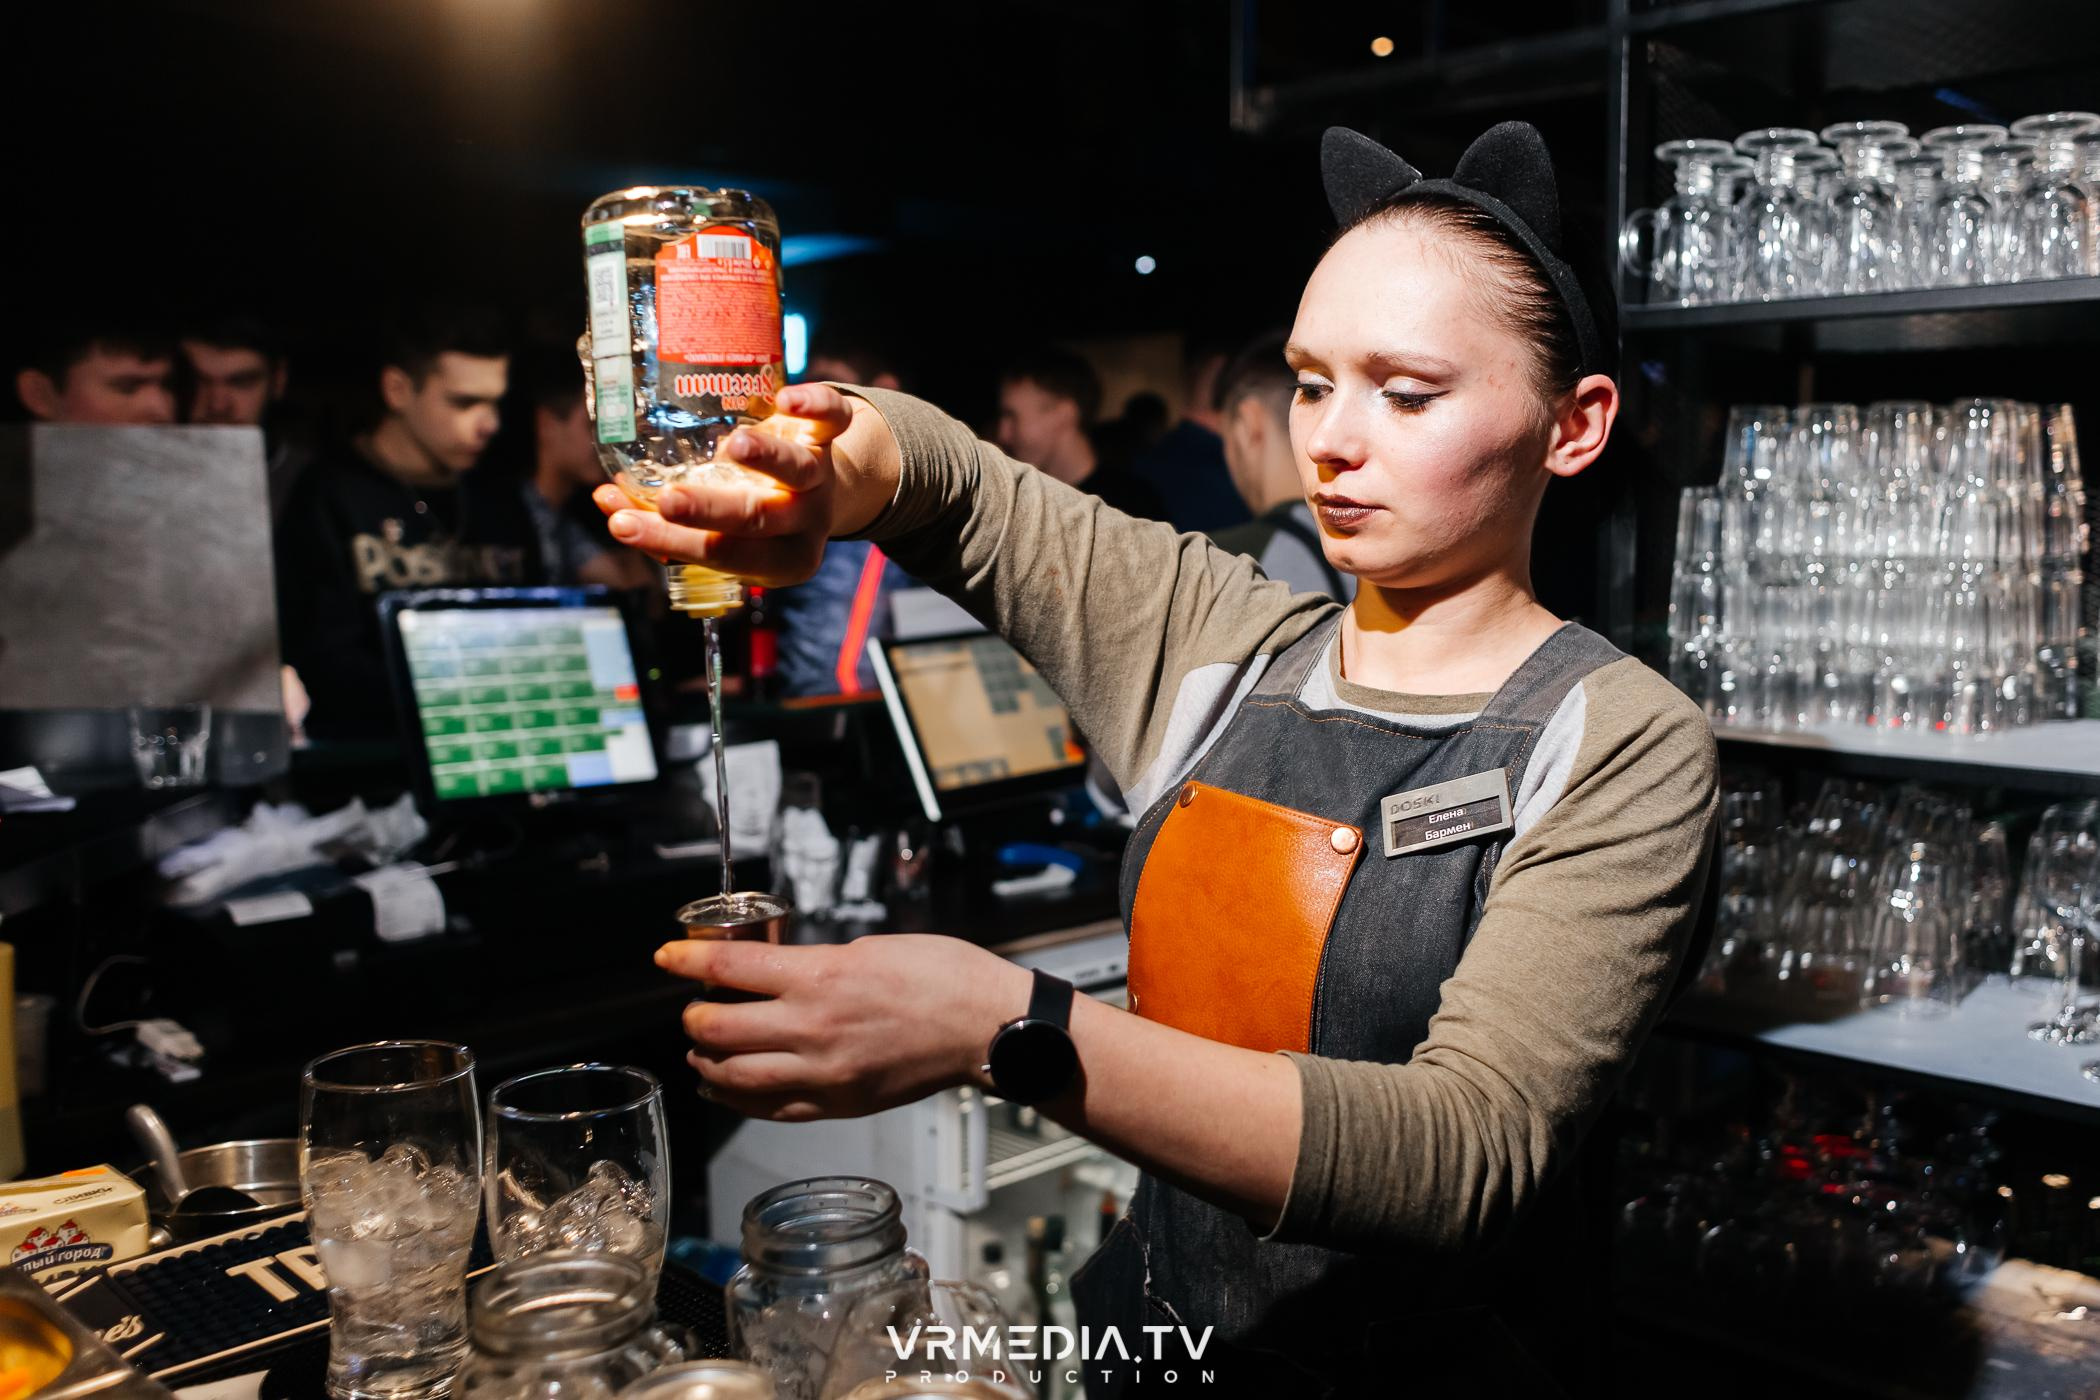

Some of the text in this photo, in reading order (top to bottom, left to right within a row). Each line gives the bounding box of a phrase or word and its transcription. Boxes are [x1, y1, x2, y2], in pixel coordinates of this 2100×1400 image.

[722, 394, 748, 411] GIN
[1428, 808, 1464, 824] Елена
[1425, 821, 1471, 841] Бармен
[58, 1246, 102, 1265] город
